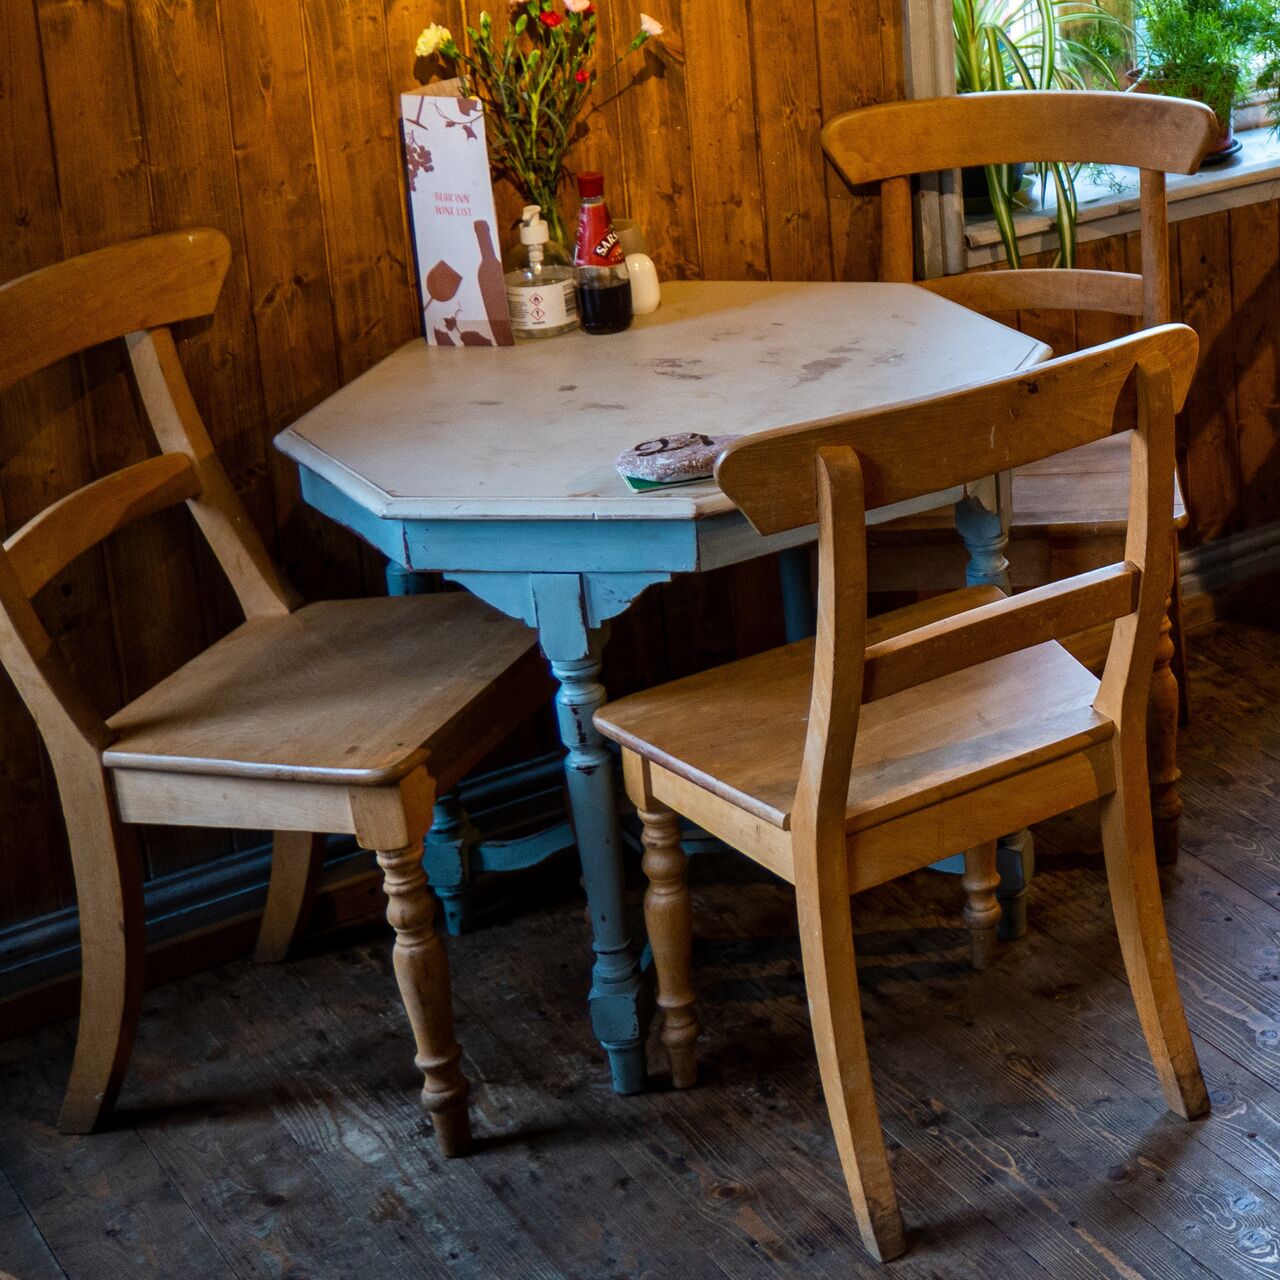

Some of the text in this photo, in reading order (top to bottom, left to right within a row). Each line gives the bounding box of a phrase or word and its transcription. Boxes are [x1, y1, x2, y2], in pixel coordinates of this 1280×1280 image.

[455, 193, 470, 204] INN
[435, 206, 472, 216] WINE LIST
